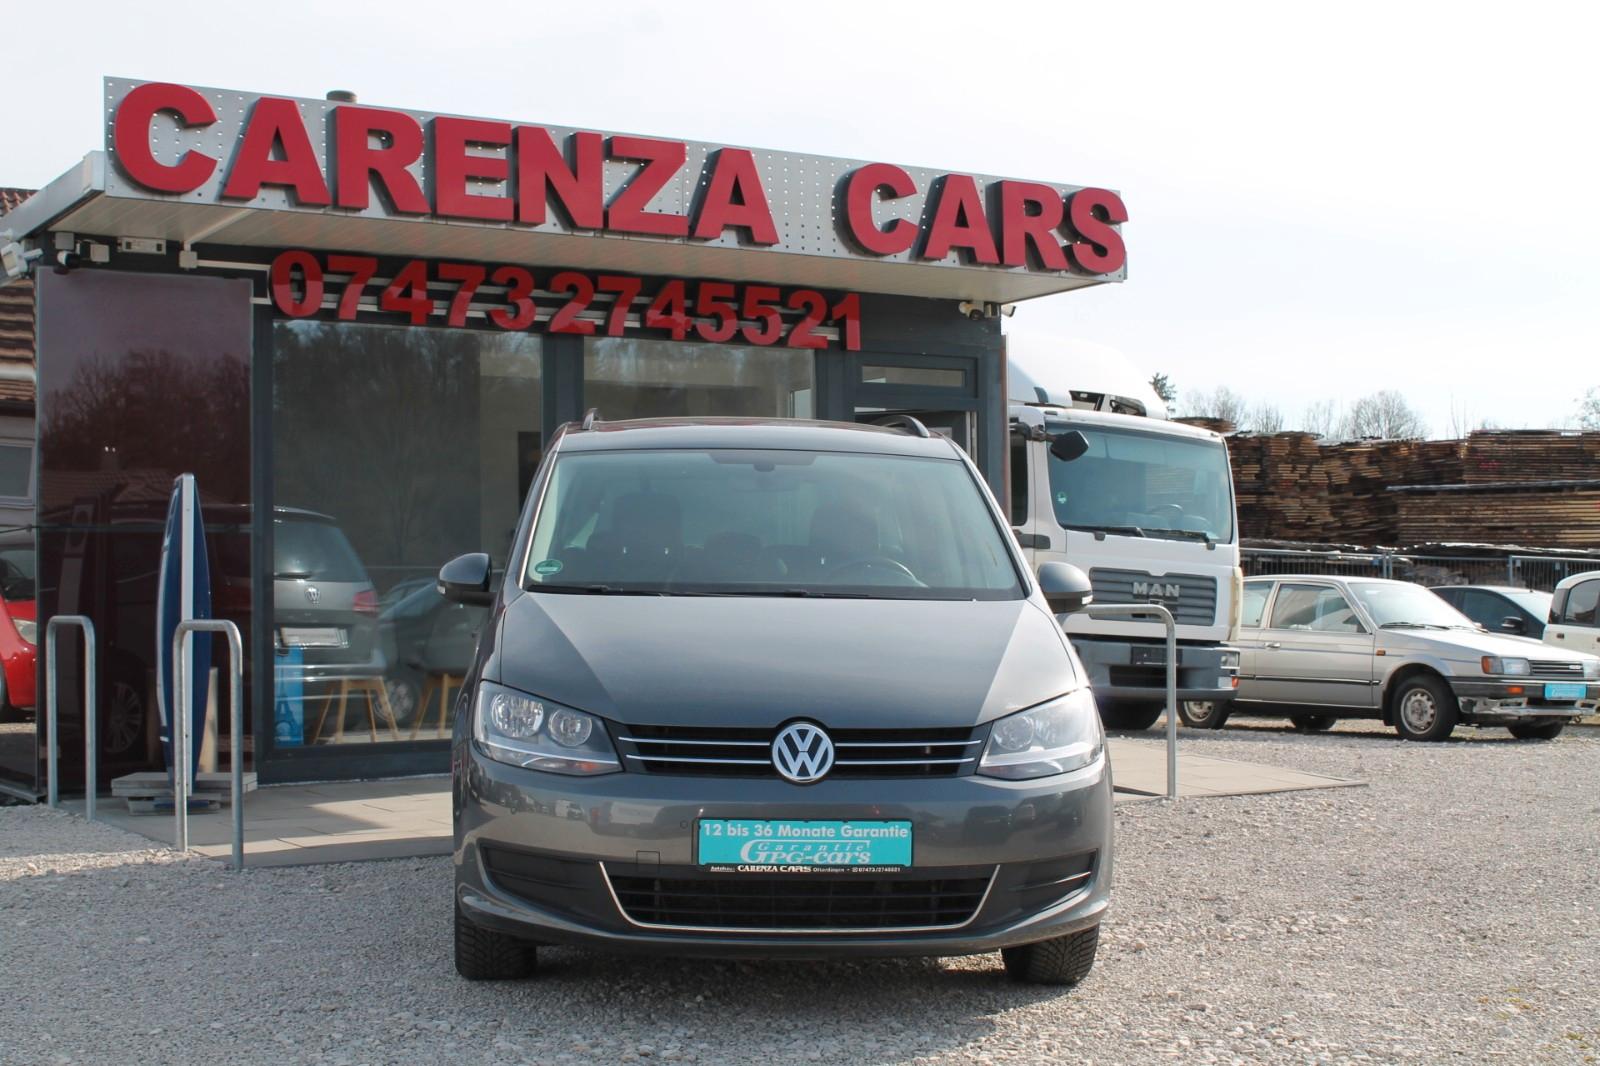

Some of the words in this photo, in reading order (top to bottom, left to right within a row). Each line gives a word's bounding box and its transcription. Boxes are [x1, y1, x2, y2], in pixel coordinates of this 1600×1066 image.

[113, 83, 780, 246] CARENZA
[835, 162, 1129, 275] CARS
[1132, 582, 1180, 597] MAN
[704, 823, 722, 836] 12
[727, 824, 749, 837] bis
[754, 824, 773, 837] 36
[777, 824, 836, 837] Monate
[841, 825, 909, 838] Garantie
